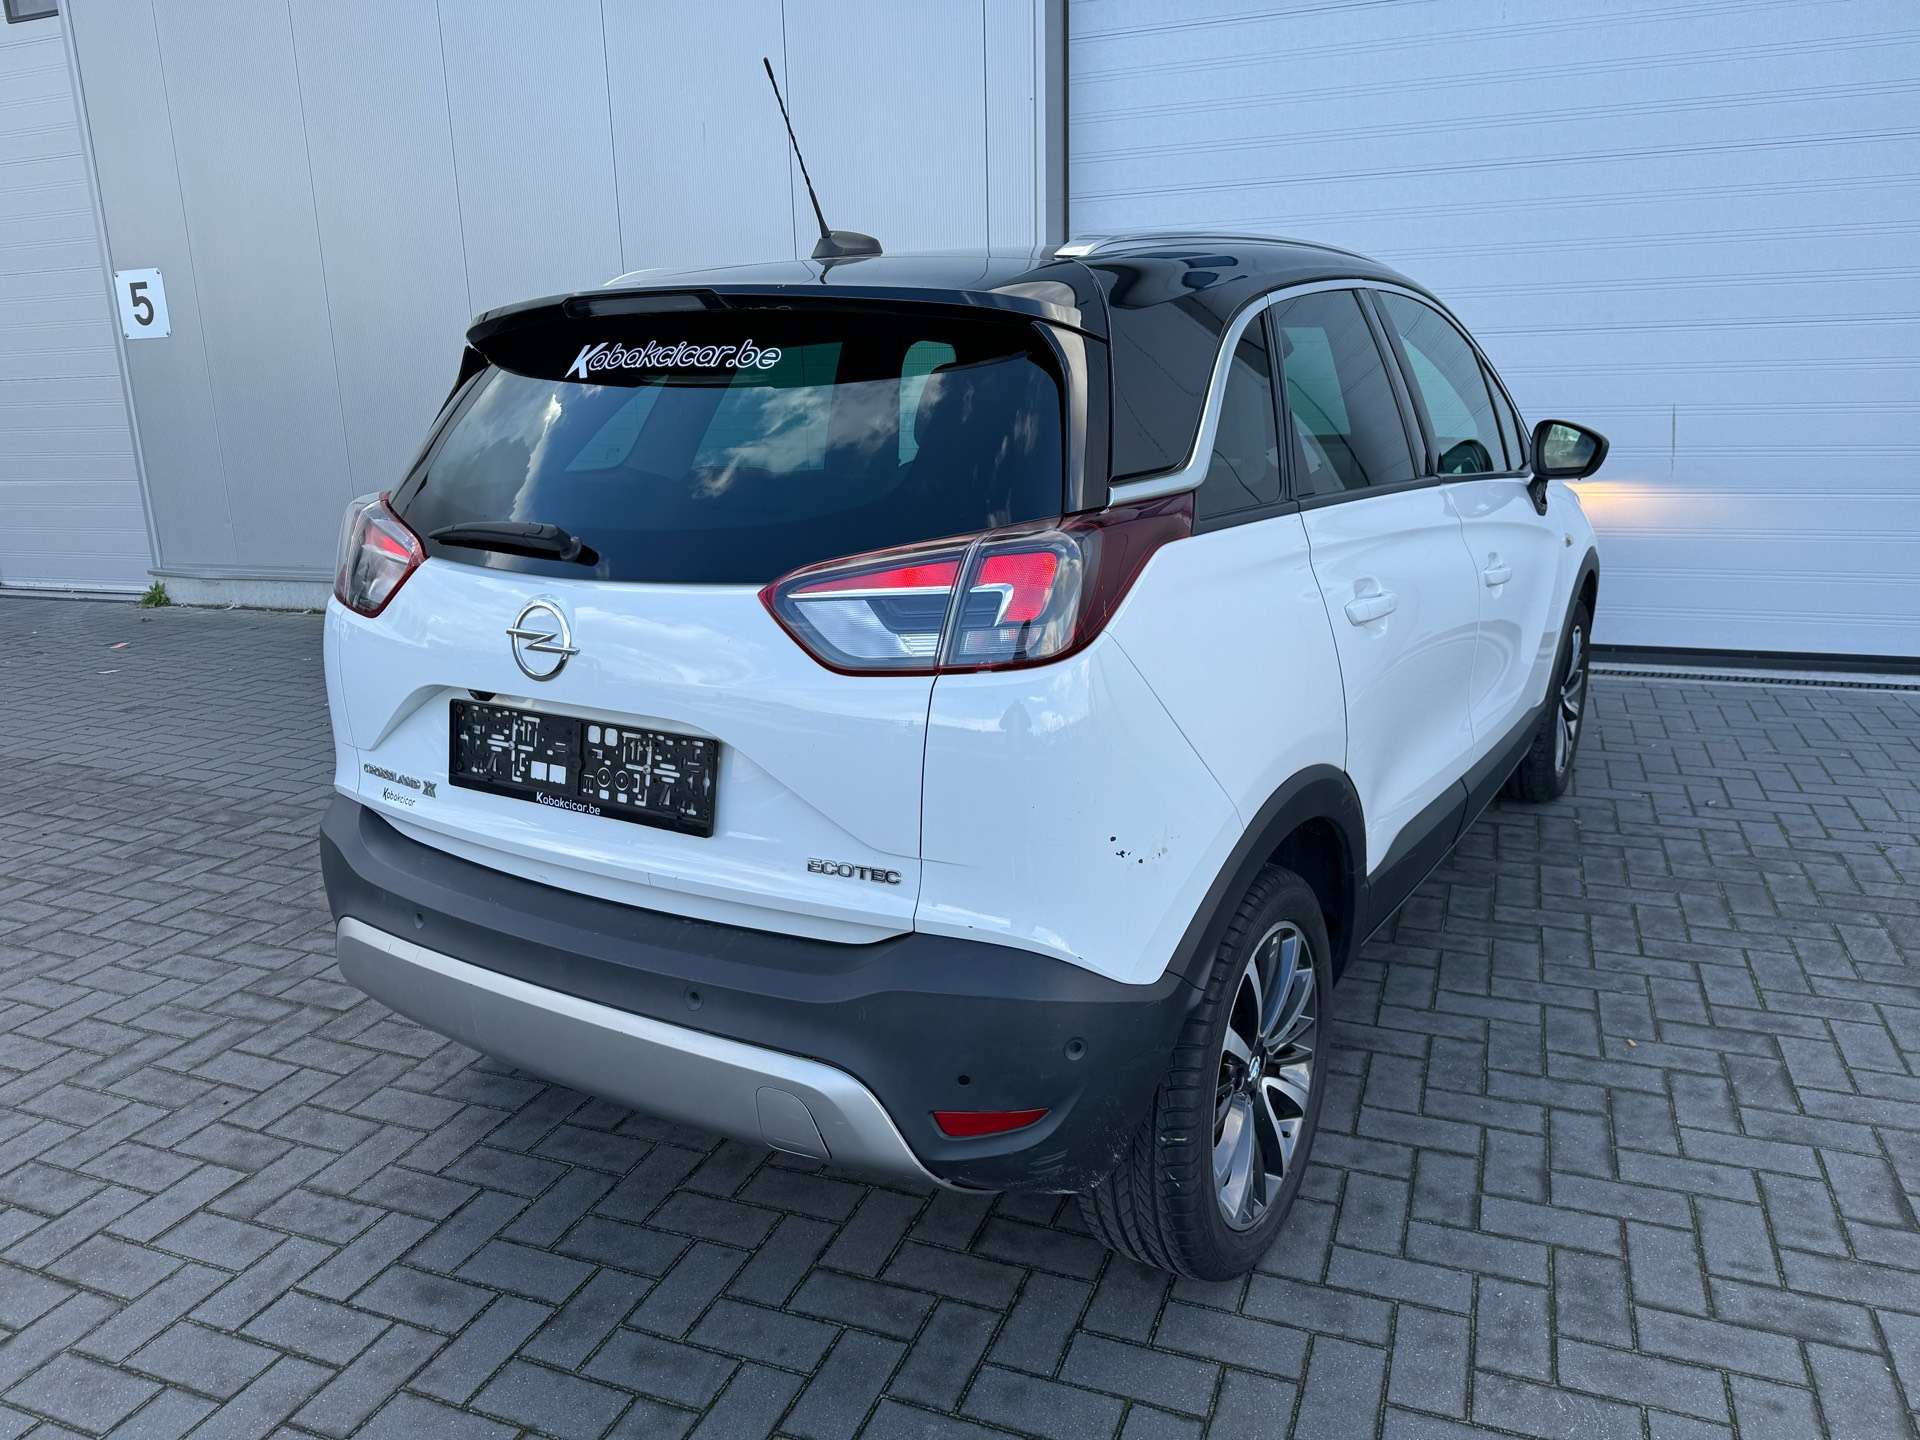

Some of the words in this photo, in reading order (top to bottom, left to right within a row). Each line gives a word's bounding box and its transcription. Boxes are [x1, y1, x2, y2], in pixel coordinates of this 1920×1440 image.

[129, 281, 154, 326] 5
[565, 339, 782, 379] Kabakcicar.be
[383, 787, 416, 807] Kabakcicar
[536, 791, 601, 815] Kabakcicar.be
[807, 857, 902, 885] ECOTEC
